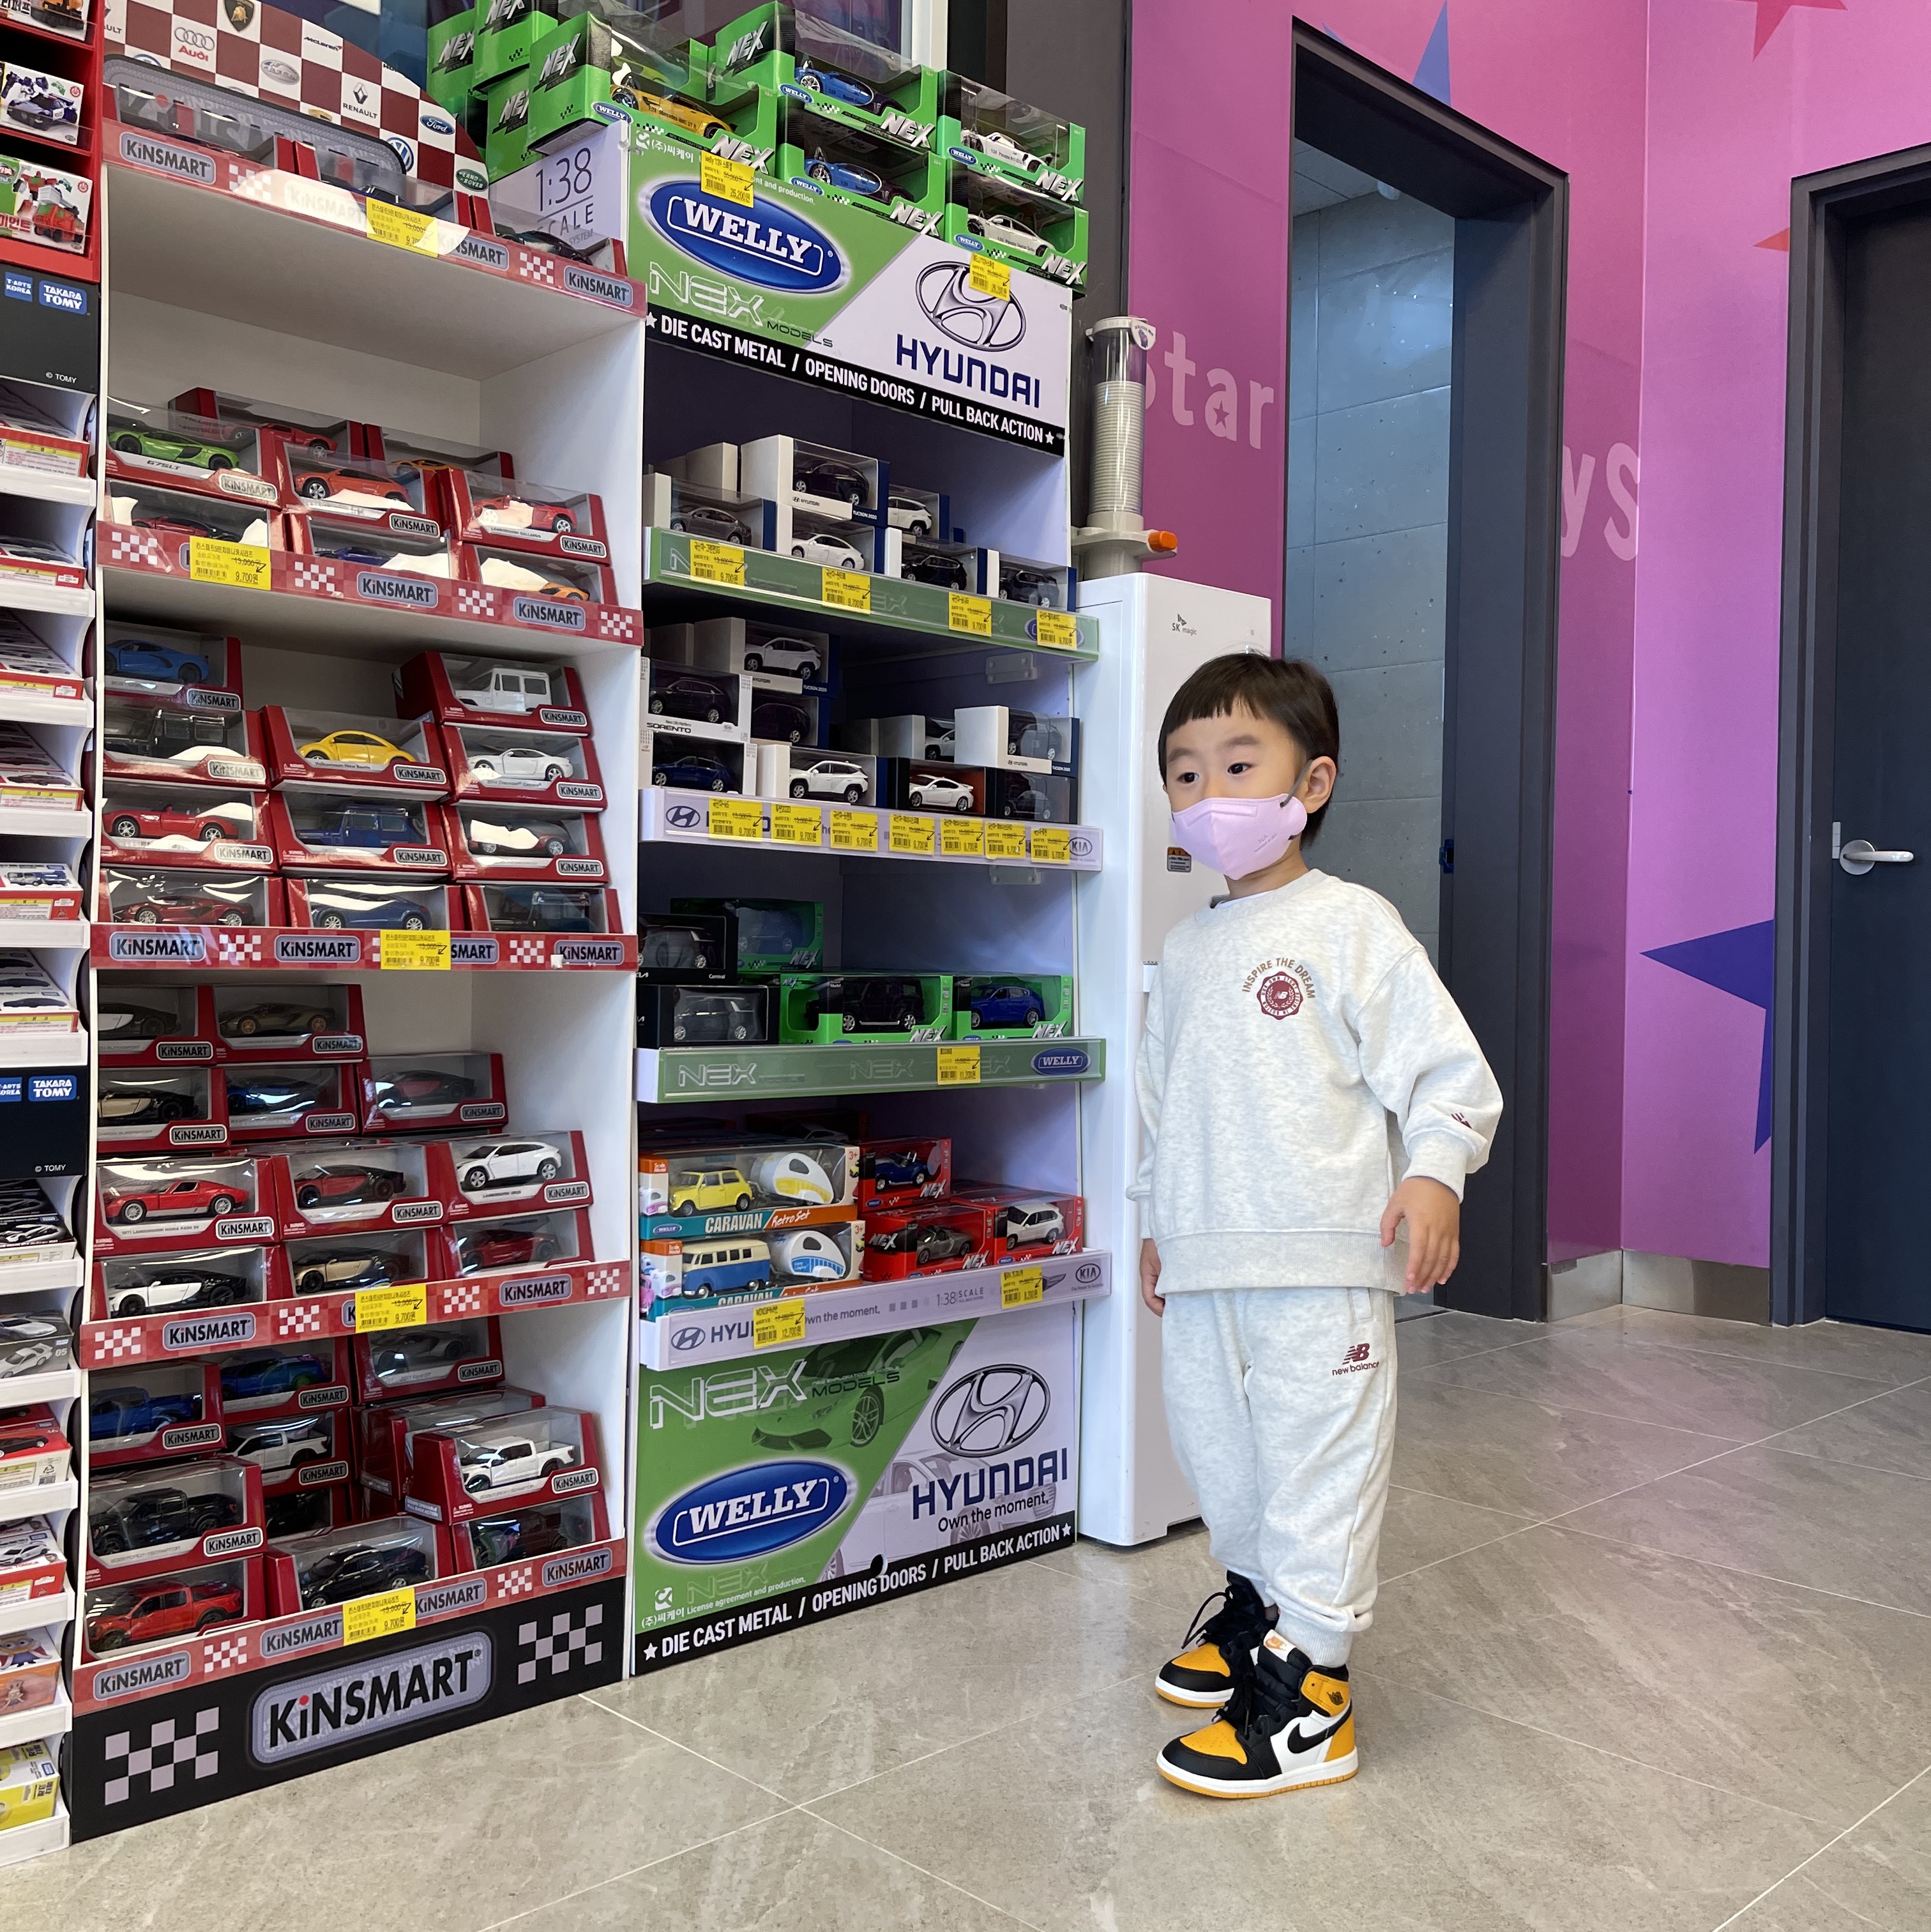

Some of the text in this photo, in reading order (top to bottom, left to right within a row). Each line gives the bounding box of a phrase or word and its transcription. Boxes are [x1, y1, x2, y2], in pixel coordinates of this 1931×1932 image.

[179, 45, 209, 61] Audi
[438, 31, 474, 63] NEX
[726, 21, 768, 66] NEX
[538, 33, 582, 82] NEX
[785, 88, 808, 100] WELLY
[343, 103, 377, 119] RENAULT
[598, 105, 626, 119] WELLY
[426, 118, 448, 133] Ford
[880, 111, 935, 149] NEX
[710, 135, 775, 174] NEX
[952, 148, 974, 161] WELLY
[463, 178, 483, 190] ROVER
[536, 148, 592, 211] 1:38
[764, 180, 777, 190] and
[796, 180, 817, 192] WELLY
[1035, 169, 1084, 202] NEX
[890, 201, 944, 237] NEX
[683, 199, 812, 263] WELLY
[959, 236, 979, 248] WELLY
[1029, 268, 1051, 279] MODELS
[1041, 253, 1087, 285] NEX
[6, 284, 31, 296] KOREA
[43, 285, 82, 301] TAKARA
[649, 261, 764, 326] NEX
[43, 293, 82, 310] TOMY
[767, 320, 833, 348] MODELS
[55, 373, 77, 384] TOMY
[662, 315, 1043, 444] DIE CAST METAL / OPENING DOORS / PULL BACK ACTION
[895, 333, 1040, 409] HYUNDAI
[1145, 330, 1275, 450] tar
[1172, 621, 1197, 636] SK magic
[646, 722, 692, 734] SORENTO
[1071, 842, 1089, 851] KIA
[789, 949, 821, 968] NEX
[1242, 957, 1315, 998] INSPIRE THE DREAM
[909, 1026, 947, 1042] NEX
[1033, 1021, 1068, 1038] NEX
[1043, 1055, 1080, 1066] WELLY
[33, 1079, 73, 1088] TAKARA
[678, 1062, 757, 1088] NEX
[33, 1086, 73, 1099] TOMY
[43, 1164, 66, 1173] TOMY
[920, 1179, 947, 1199] NEX
[705, 1213, 763, 1234] CARAVAN
[868, 1233, 898, 1250] NEX
[1052, 1236, 1080, 1255] NEX
[962, 1250, 989, 1270] NEX
[1079, 1268, 1097, 1279] KIA
[936, 1291, 957, 1307] 1:38
[958, 1286, 985, 1298] SCALE
[823, 1311, 841, 1322] the
[1331, 1360, 1381, 1376] new balance
[649, 1358, 808, 1429] NEX
[812, 1371, 900, 1398] MODELS
[912, 1447, 1068, 1520] HYUNDAI
[689, 1479, 818, 1534] WELLY
[938, 1513, 969, 1533] Own
[971, 1505, 992, 1524] the
[662, 1525, 1061, 1657] DIE CAST METAL / OPENING DOORS / PULL BACK ACTION
[686, 1601, 713, 1615] License
[715, 1591, 752, 1609] agreement
[753, 1586, 768, 1598] and
